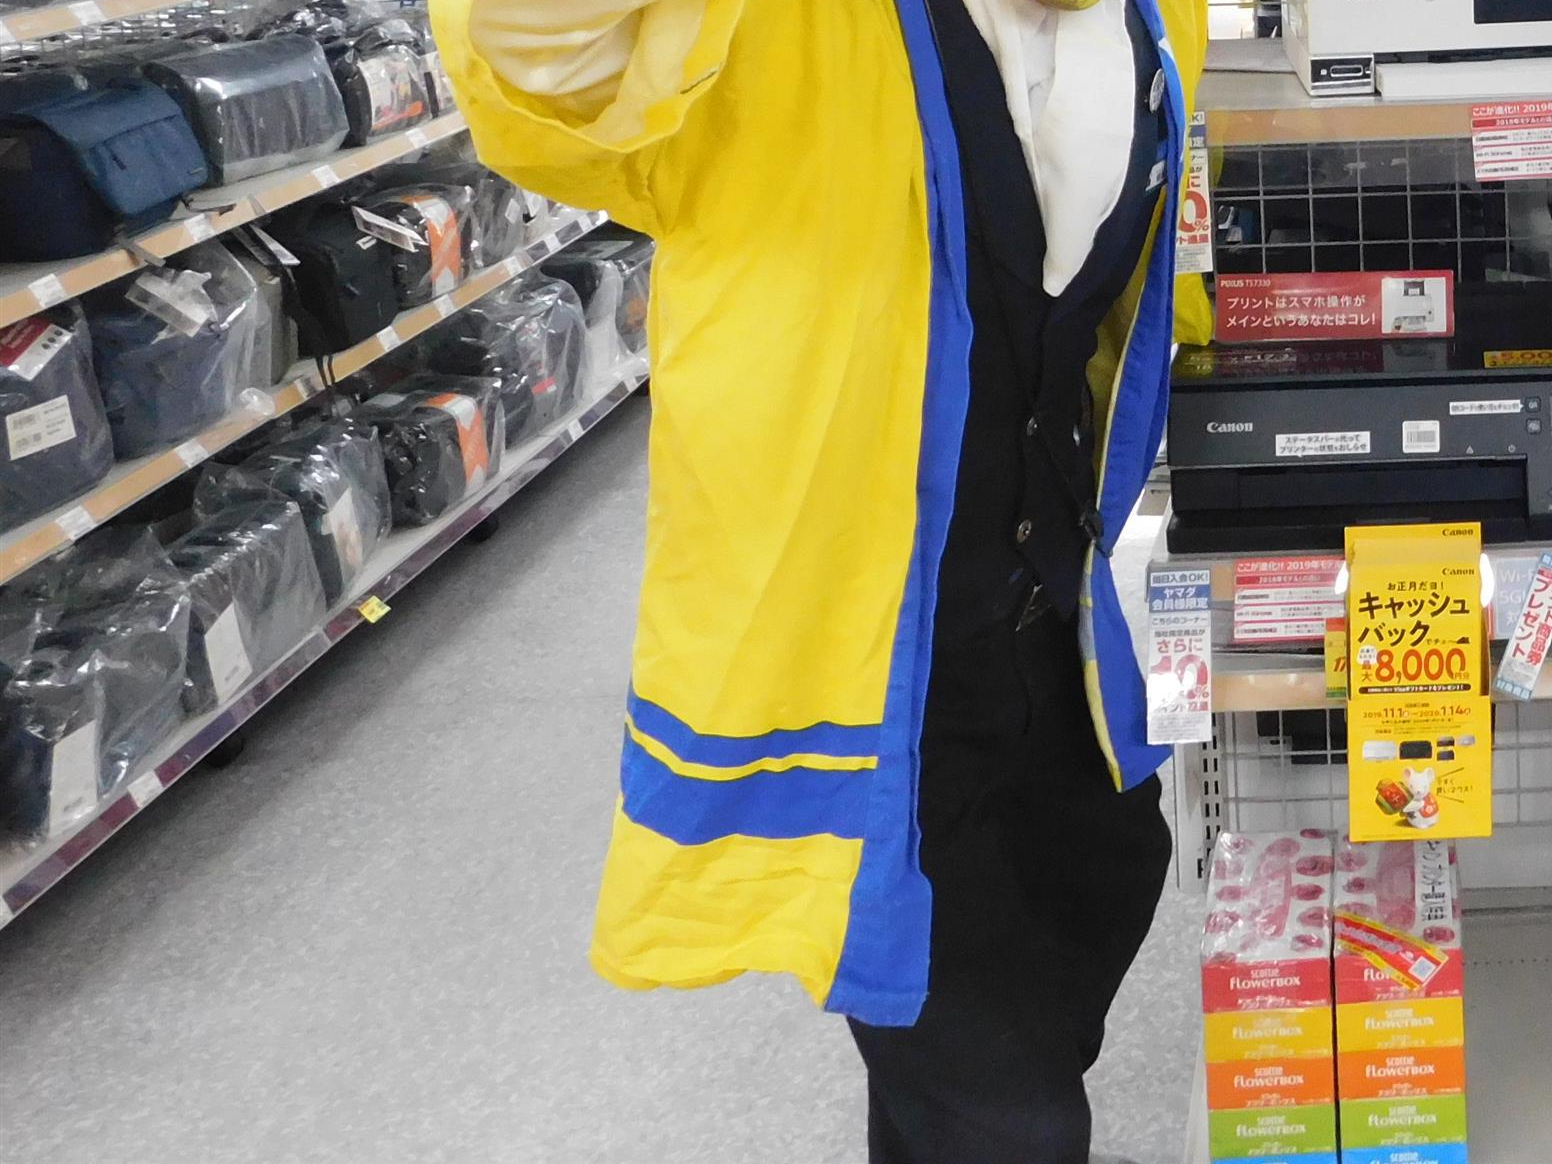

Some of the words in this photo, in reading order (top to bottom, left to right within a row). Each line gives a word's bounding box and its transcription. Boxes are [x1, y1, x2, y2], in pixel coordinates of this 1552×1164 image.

[1225, 294, 1367, 310] プリントはスマホ操作が
[1225, 312, 1377, 328] メインというあなたはコレ!
[1206, 421, 1254, 434] Canon
[1441, 528, 1474, 537] Canon
[1441, 567, 1475, 576] Canon
[1163, 587, 1197, 598] ヤマダ
[1387, 580, 1445, 592] お正月だヨ!
[1358, 591, 1471, 621] キャッシュ
[1511, 577, 1552, 659] プレゼント
[1357, 619, 1431, 648] バック
[1156, 638, 1204, 654] さらに
[1375, 647, 1467, 684] 8,000
